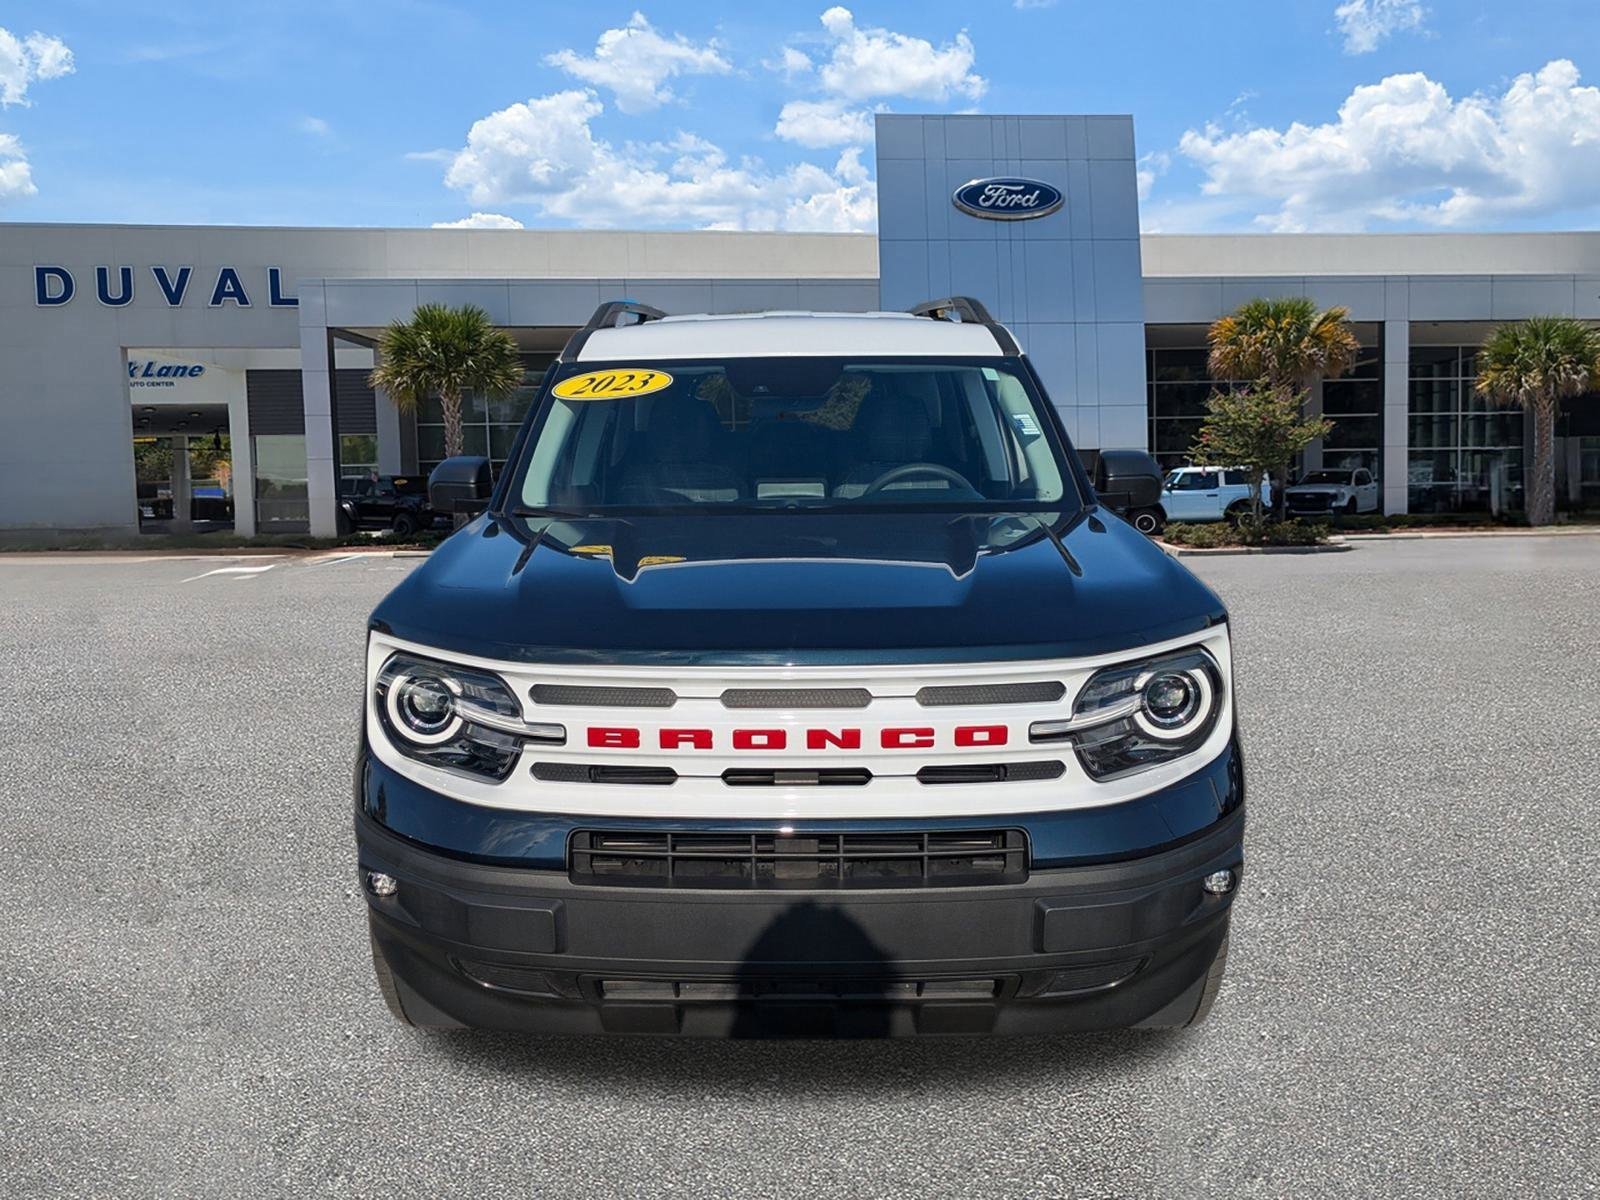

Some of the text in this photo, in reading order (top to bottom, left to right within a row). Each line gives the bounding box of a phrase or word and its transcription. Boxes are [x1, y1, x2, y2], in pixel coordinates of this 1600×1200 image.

[978, 184, 1041, 207] Ford
[34, 265, 299, 308] DUVAL
[141, 361, 205, 378] Lane
[569, 373, 656, 396] 2023
[586, 724, 1009, 751] BRONCO
